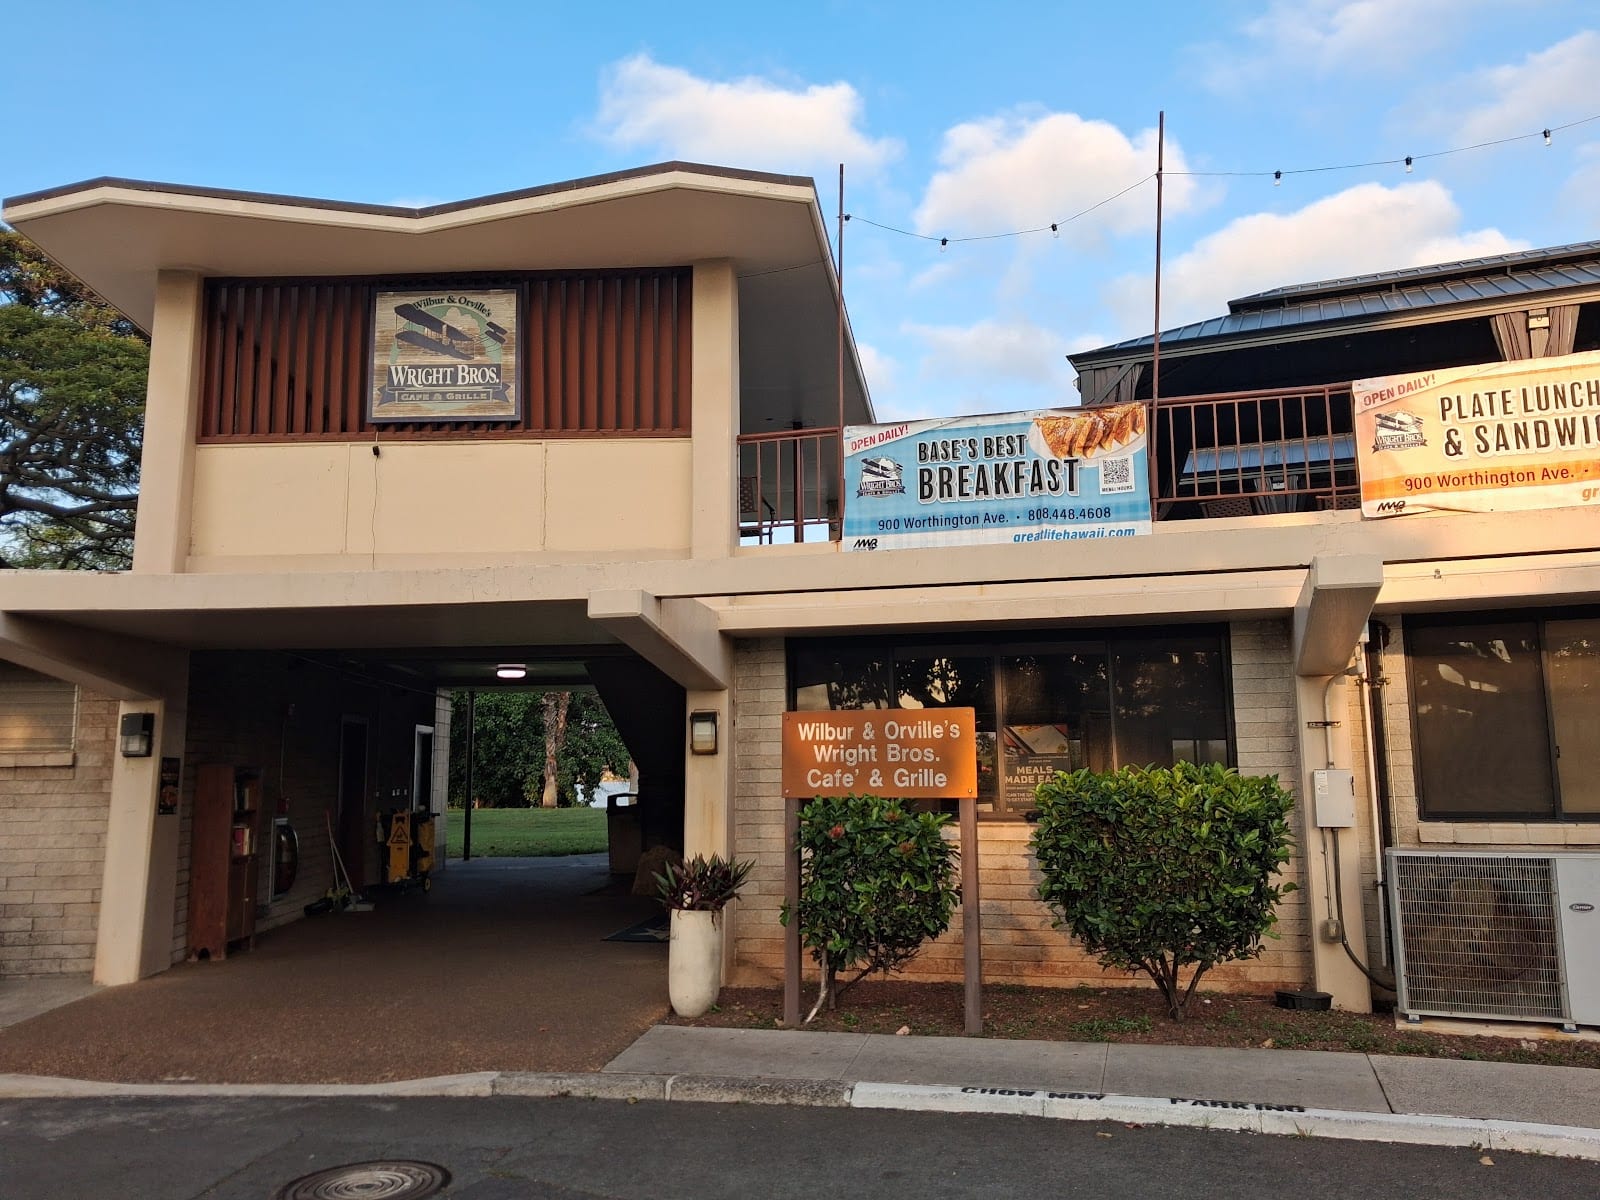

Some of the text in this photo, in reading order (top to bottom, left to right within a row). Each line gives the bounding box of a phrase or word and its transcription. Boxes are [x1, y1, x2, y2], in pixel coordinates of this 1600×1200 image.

[412, 295, 492, 317] Wilbur & Orville's
[390, 364, 500, 387] WRIGHT BROS.
[1363, 374, 1436, 407] OPEN DAILY!
[1440, 379, 1600, 422] PLATE LUNCH
[851, 424, 909, 451] OPEN DAILY!
[918, 438, 979, 462] BASE'S
[983, 434, 1028, 458] BEST
[1444, 428, 1464, 457] &
[919, 458, 1081, 501] BREAKFAST
[1405, 466, 1574, 492] 900 Worthington Ave.
[878, 506, 1111, 531] 900 Worthington Ave. 808.448.4608
[1013, 527, 1136, 543] greatlifehawaii.com
[797, 719, 961, 741] Wilbur & Orville's
[813, 743, 941, 766] Wright Bros.
[806, 767, 948, 789] Cafe' & Grille
[1005, 775, 1059, 784] MADE EAS
[1016, 766, 1053, 775] MEALS
[961, 1086, 1305, 1112] CHOW NOW PARKING
